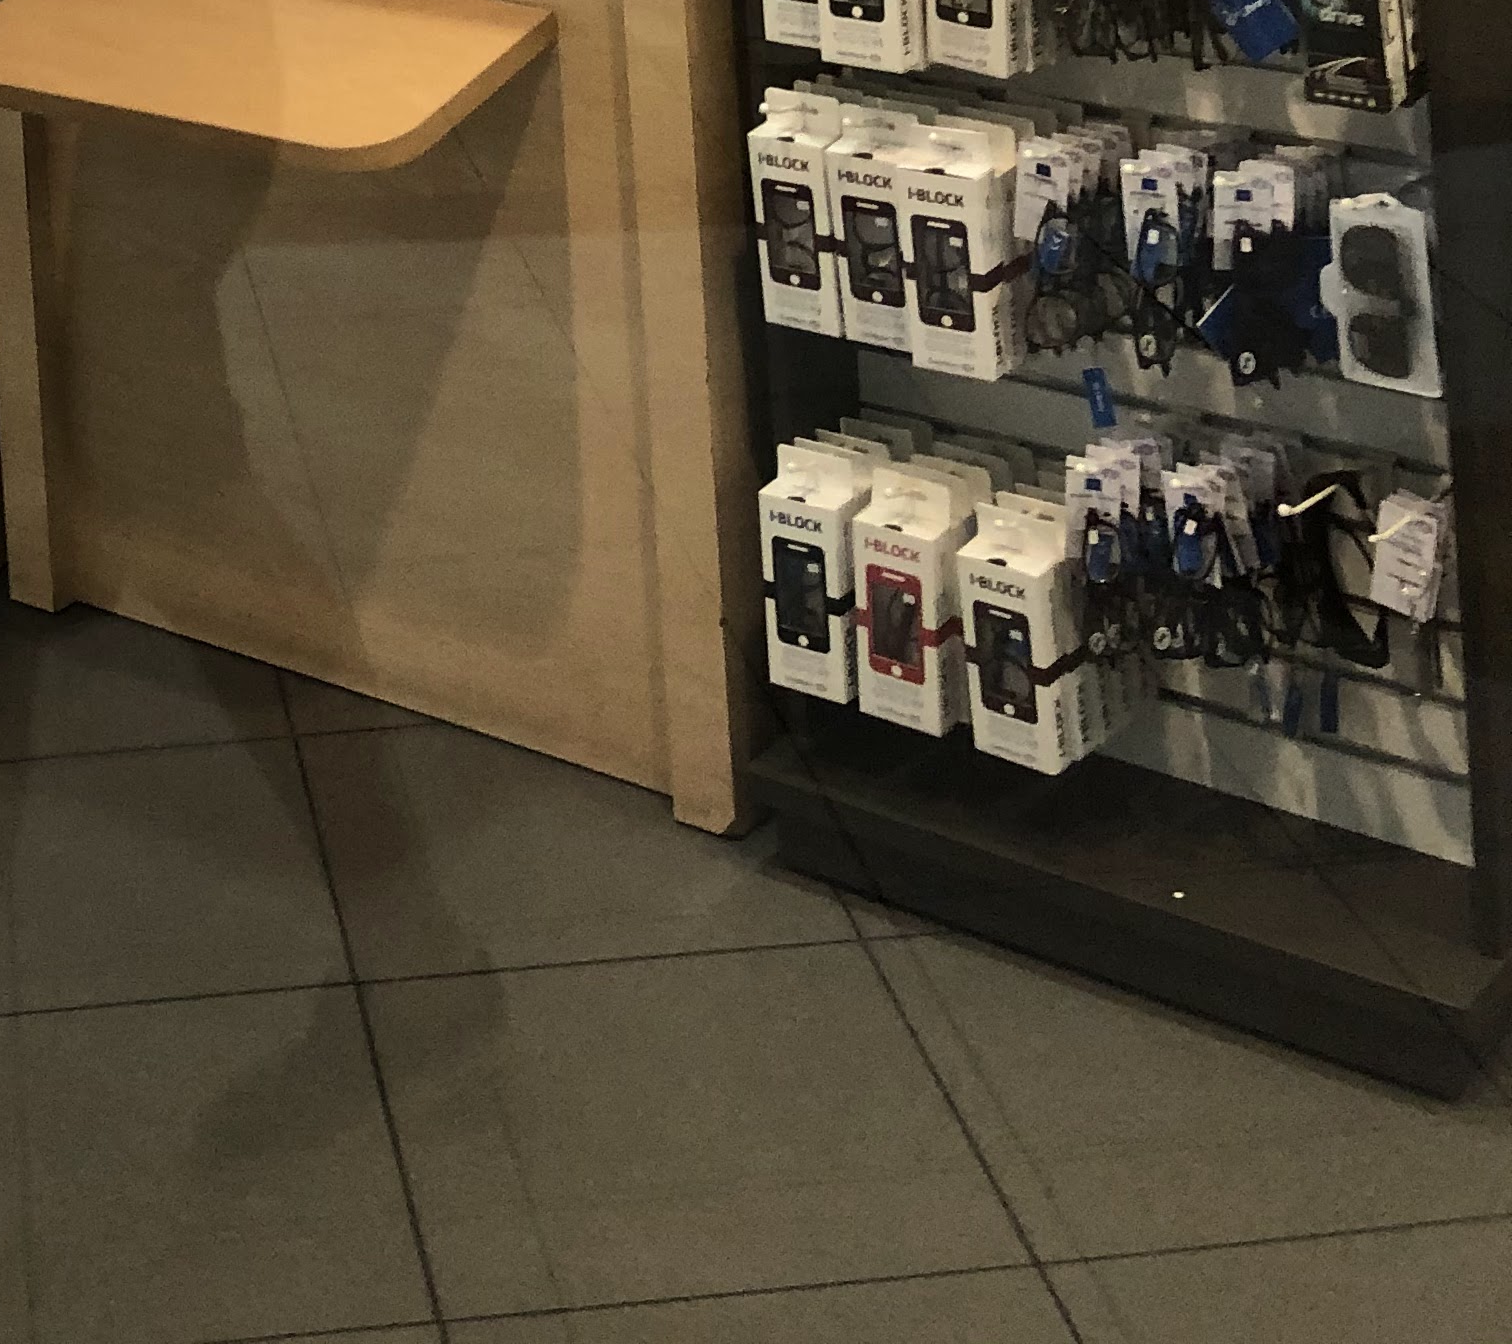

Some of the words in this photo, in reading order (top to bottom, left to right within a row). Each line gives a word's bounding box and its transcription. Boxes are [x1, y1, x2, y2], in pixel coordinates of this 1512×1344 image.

[758, 152, 809, 172] I-BLOCK
[838, 169, 893, 190] I-BLOCK
[907, 186, 964, 208] I-BLOCK
[769, 509, 823, 534] I-BLOCK
[864, 536, 921, 563] I-BLOCK
[969, 573, 1026, 600] I-BLOCK
